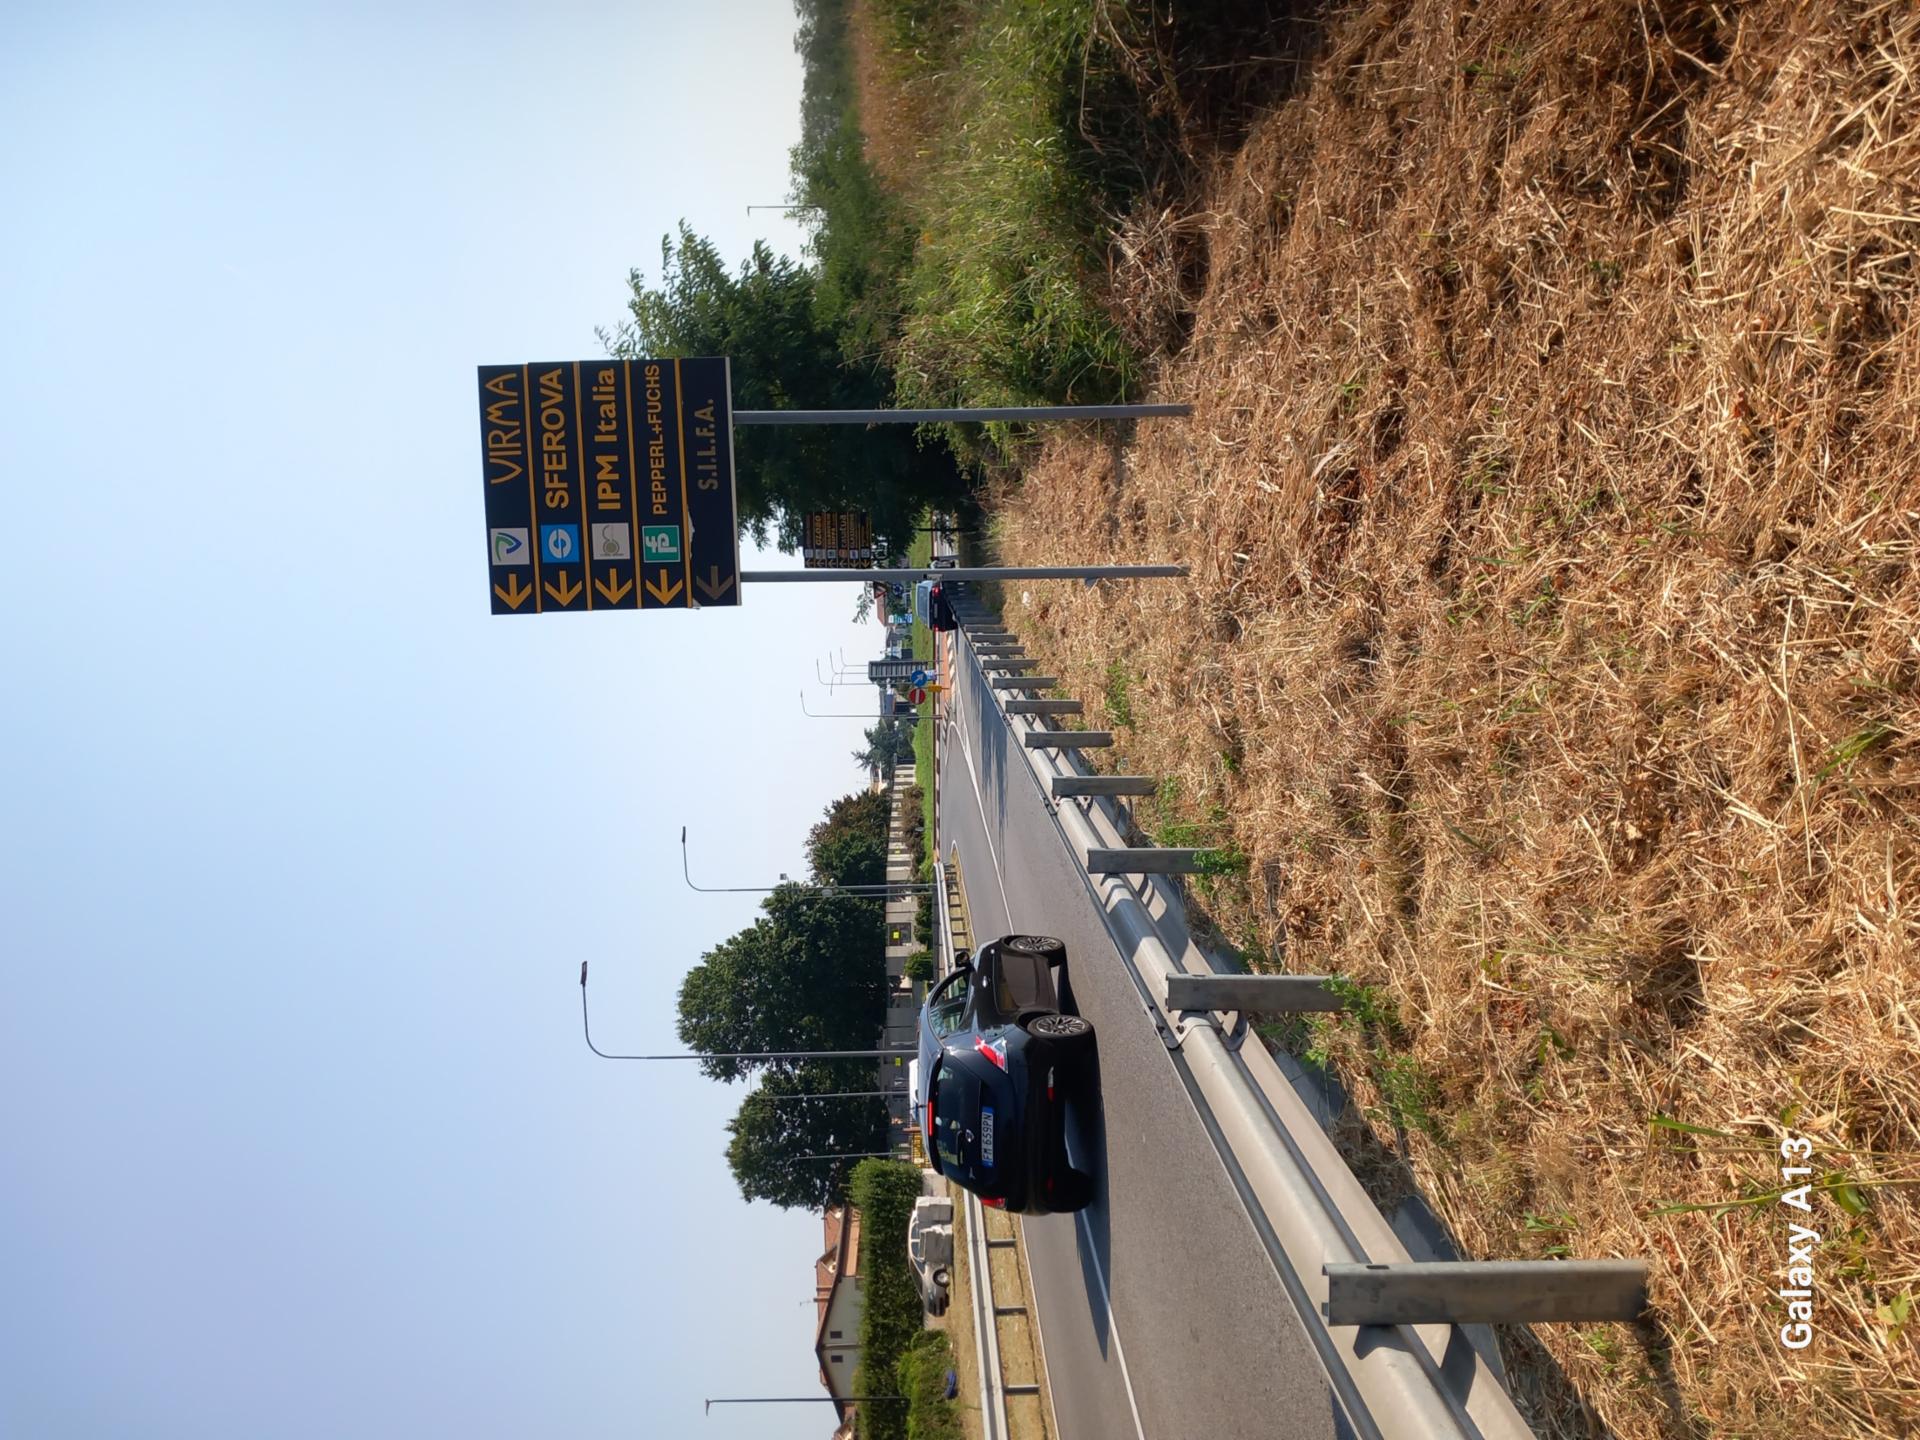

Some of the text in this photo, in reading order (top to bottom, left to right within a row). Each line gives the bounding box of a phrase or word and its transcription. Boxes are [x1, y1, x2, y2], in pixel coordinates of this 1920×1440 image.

[484, 373, 523, 485] VIRMA
[539, 368, 570, 509] SFEROVA
[592, 368, 621, 510] IPM Italia
[644, 364, 668, 515] PEPPERL+FUCHS
[695, 399, 719, 490] S.I.L.F.A.
[981, 1113, 993, 1161] FM 659PN
